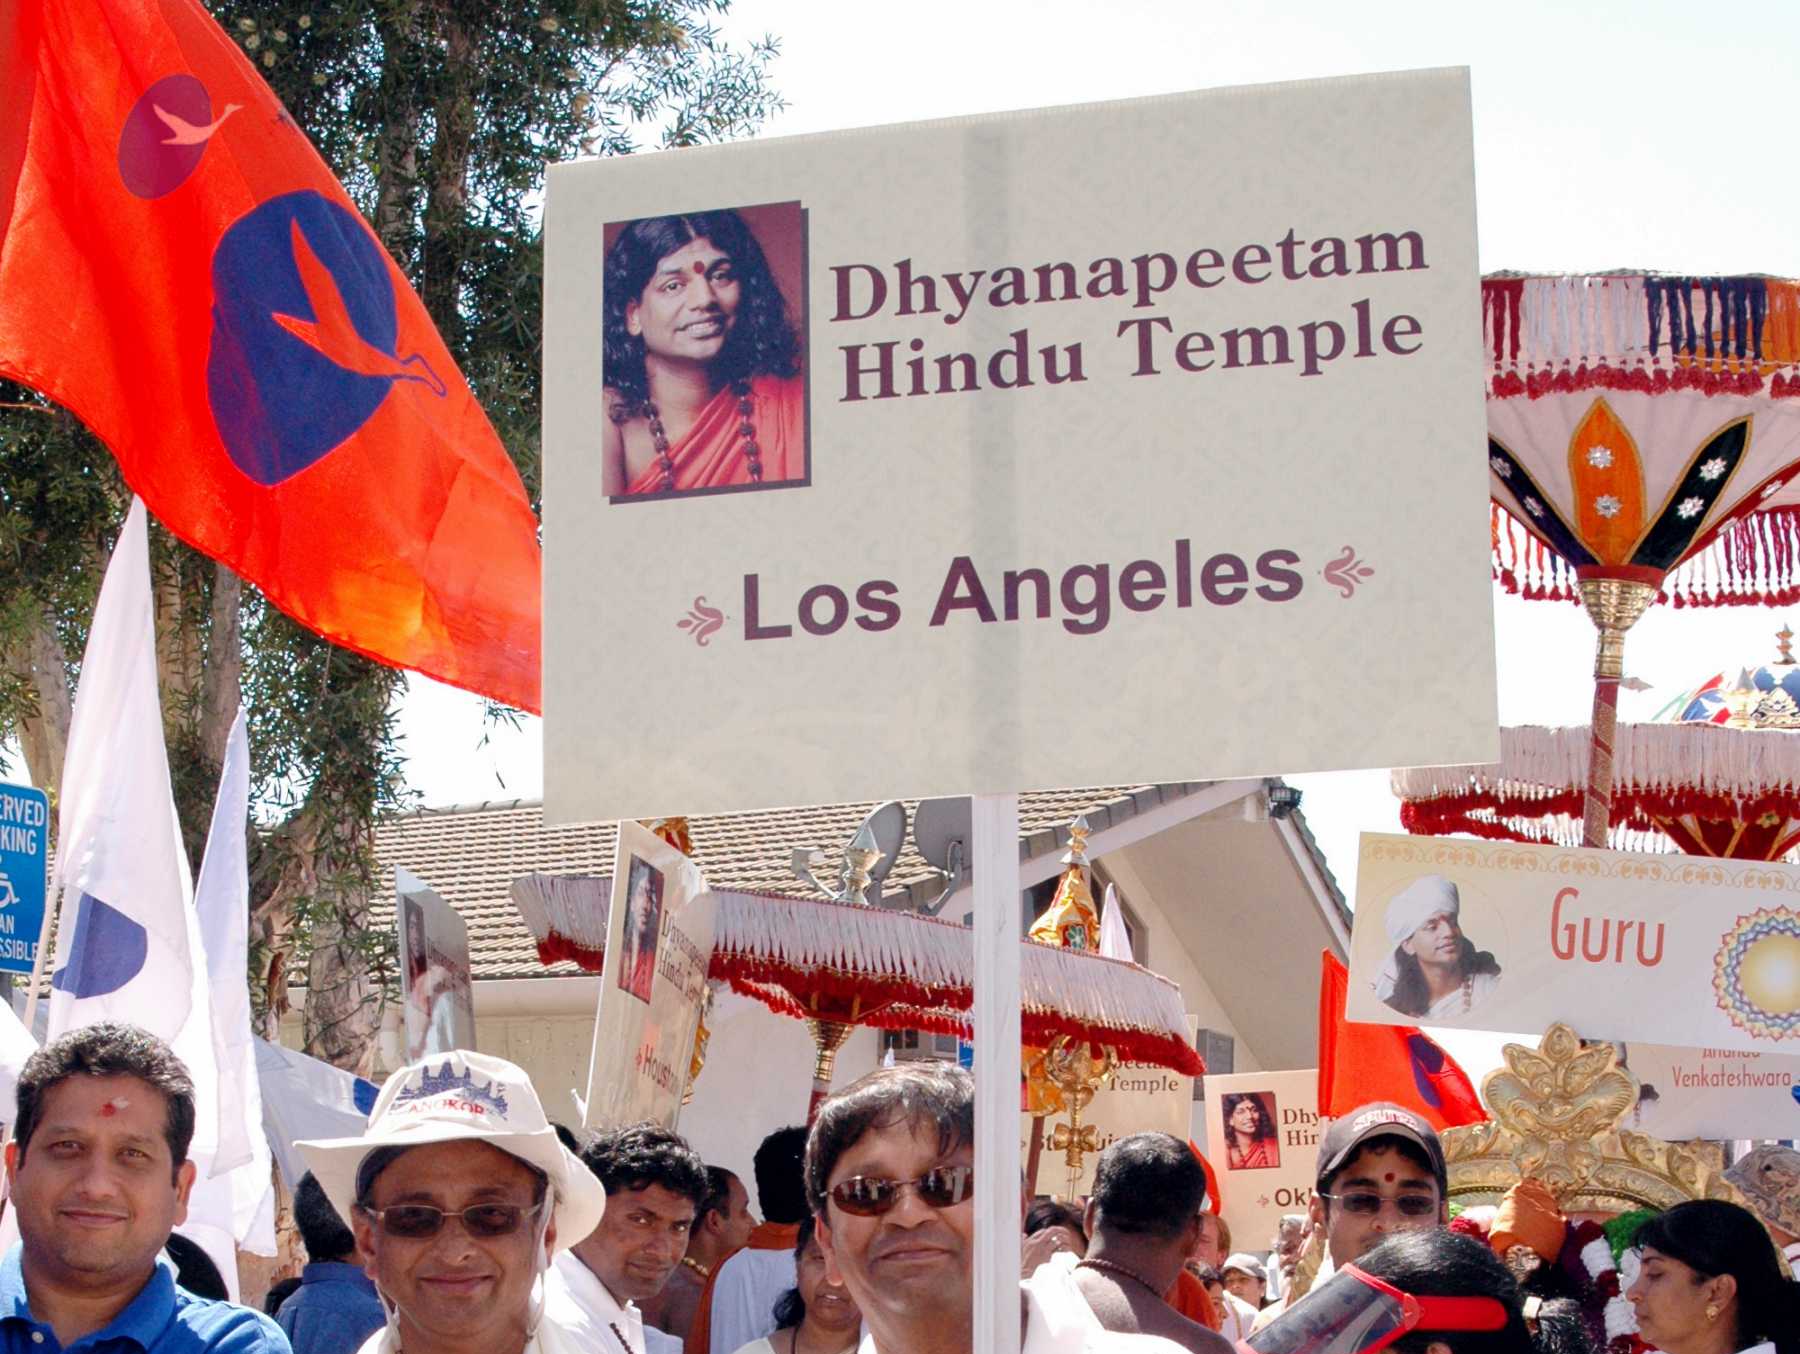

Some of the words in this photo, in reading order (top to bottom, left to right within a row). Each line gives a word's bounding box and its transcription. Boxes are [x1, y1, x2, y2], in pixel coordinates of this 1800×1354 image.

[829, 227, 1431, 326] Dhyanapeetam
[838, 328, 1088, 402] Hindu
[1116, 297, 1424, 377] Temple
[743, 572, 901, 640] Los
[928, 538, 1304, 635] Angeles
[1550, 887, 1665, 967] Guru
[1672, 1063, 1792, 1088] Venkateshwara
